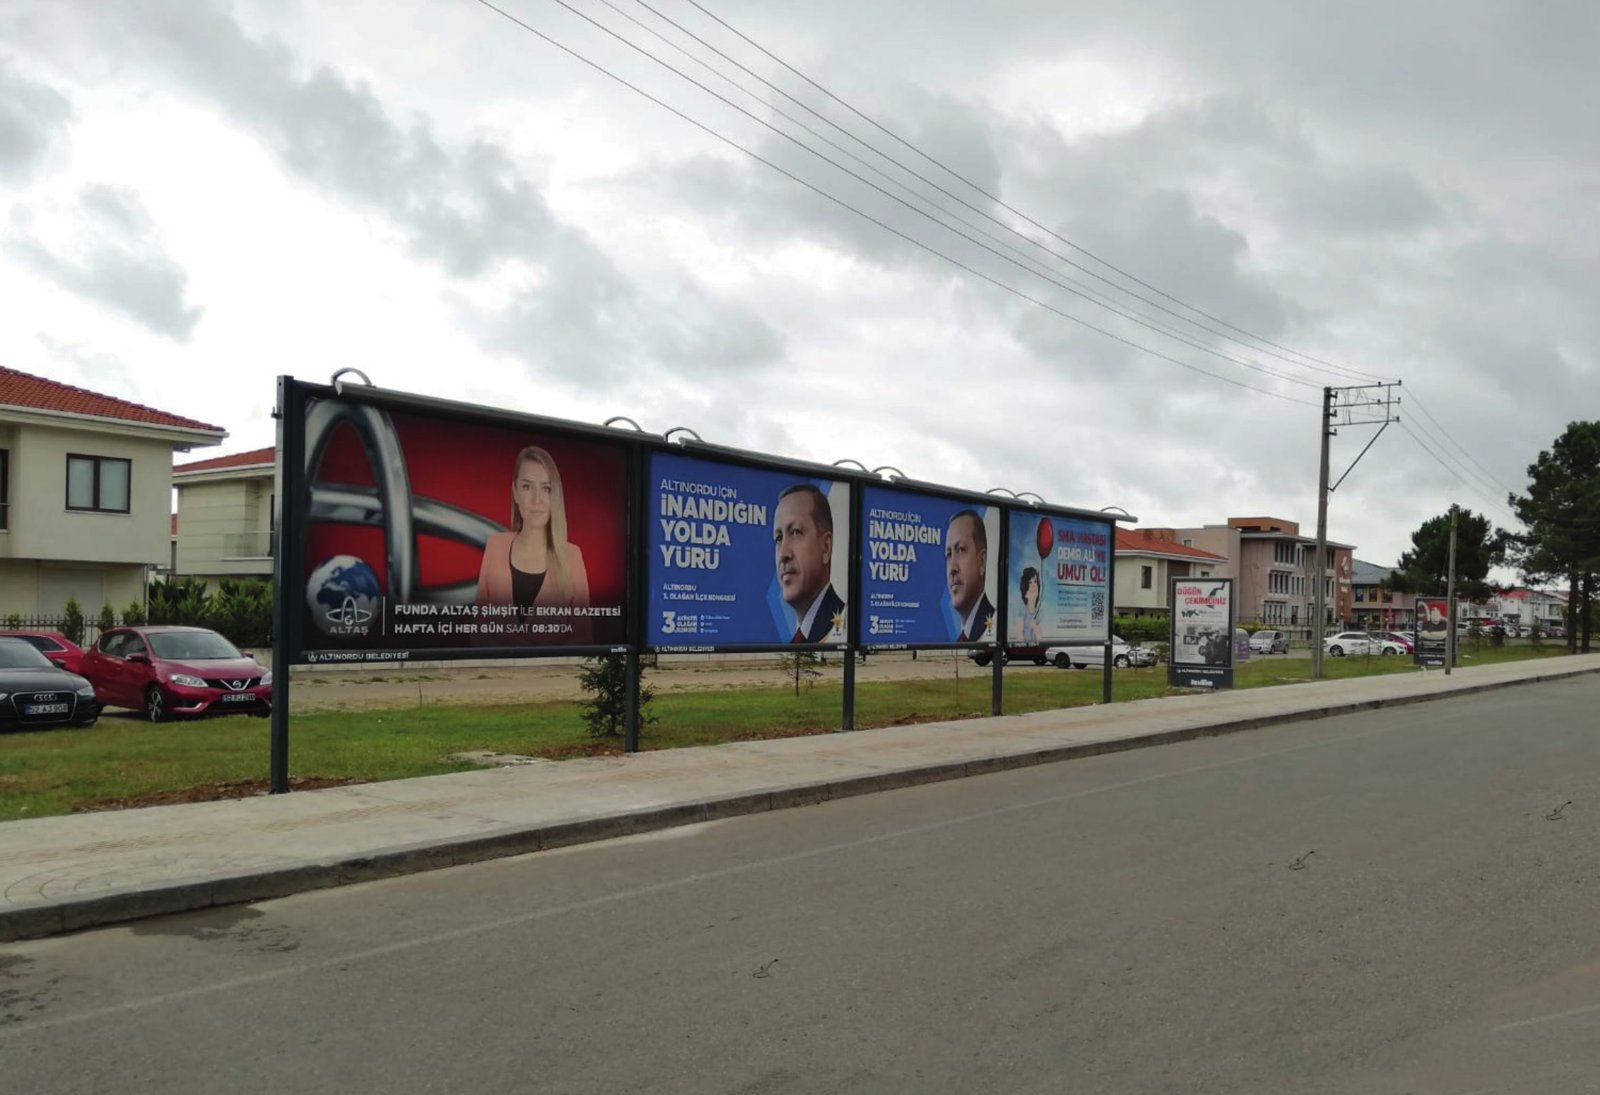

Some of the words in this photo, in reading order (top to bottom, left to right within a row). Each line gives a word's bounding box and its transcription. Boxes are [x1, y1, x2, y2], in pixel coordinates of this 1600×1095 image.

[661, 480, 717, 496] ALTINORDU
[719, 486, 737, 500] İÇİN
[661, 494, 767, 526] İNANDIĞIN
[869, 508, 907, 521] ALTINORDU
[660, 519, 731, 546] YOLDA
[869, 520, 941, 545] İNANDIĞIN
[660, 545, 719, 569] YÜRÜ
[869, 541, 917, 562] YOLDA
[869, 562, 909, 582] YÜRÜ
[1057, 563, 1087, 581] UMUT
[395, 604, 438, 615] FUNDA
[440, 605, 478, 618] ALTAŞ
[481, 604, 518, 618] ŞİMŞİT
[520, 605, 534, 616] İLE
[536, 607, 572, 616] EKRAN
[573, 605, 621, 617] GAZETESİ
[329, 626, 369, 635] ALTAŞ
[394, 624, 435, 634] HAFTA
[438, 621, 452, 636] İÇİ
[455, 624, 478, 634] HER
[480, 621, 504, 633] GÜN
[506, 623, 529, 633] SAAT
[661, 611, 676, 634] 3
[869, 615, 879, 635] 3
[319, 652, 363, 661] ALTINORDU
